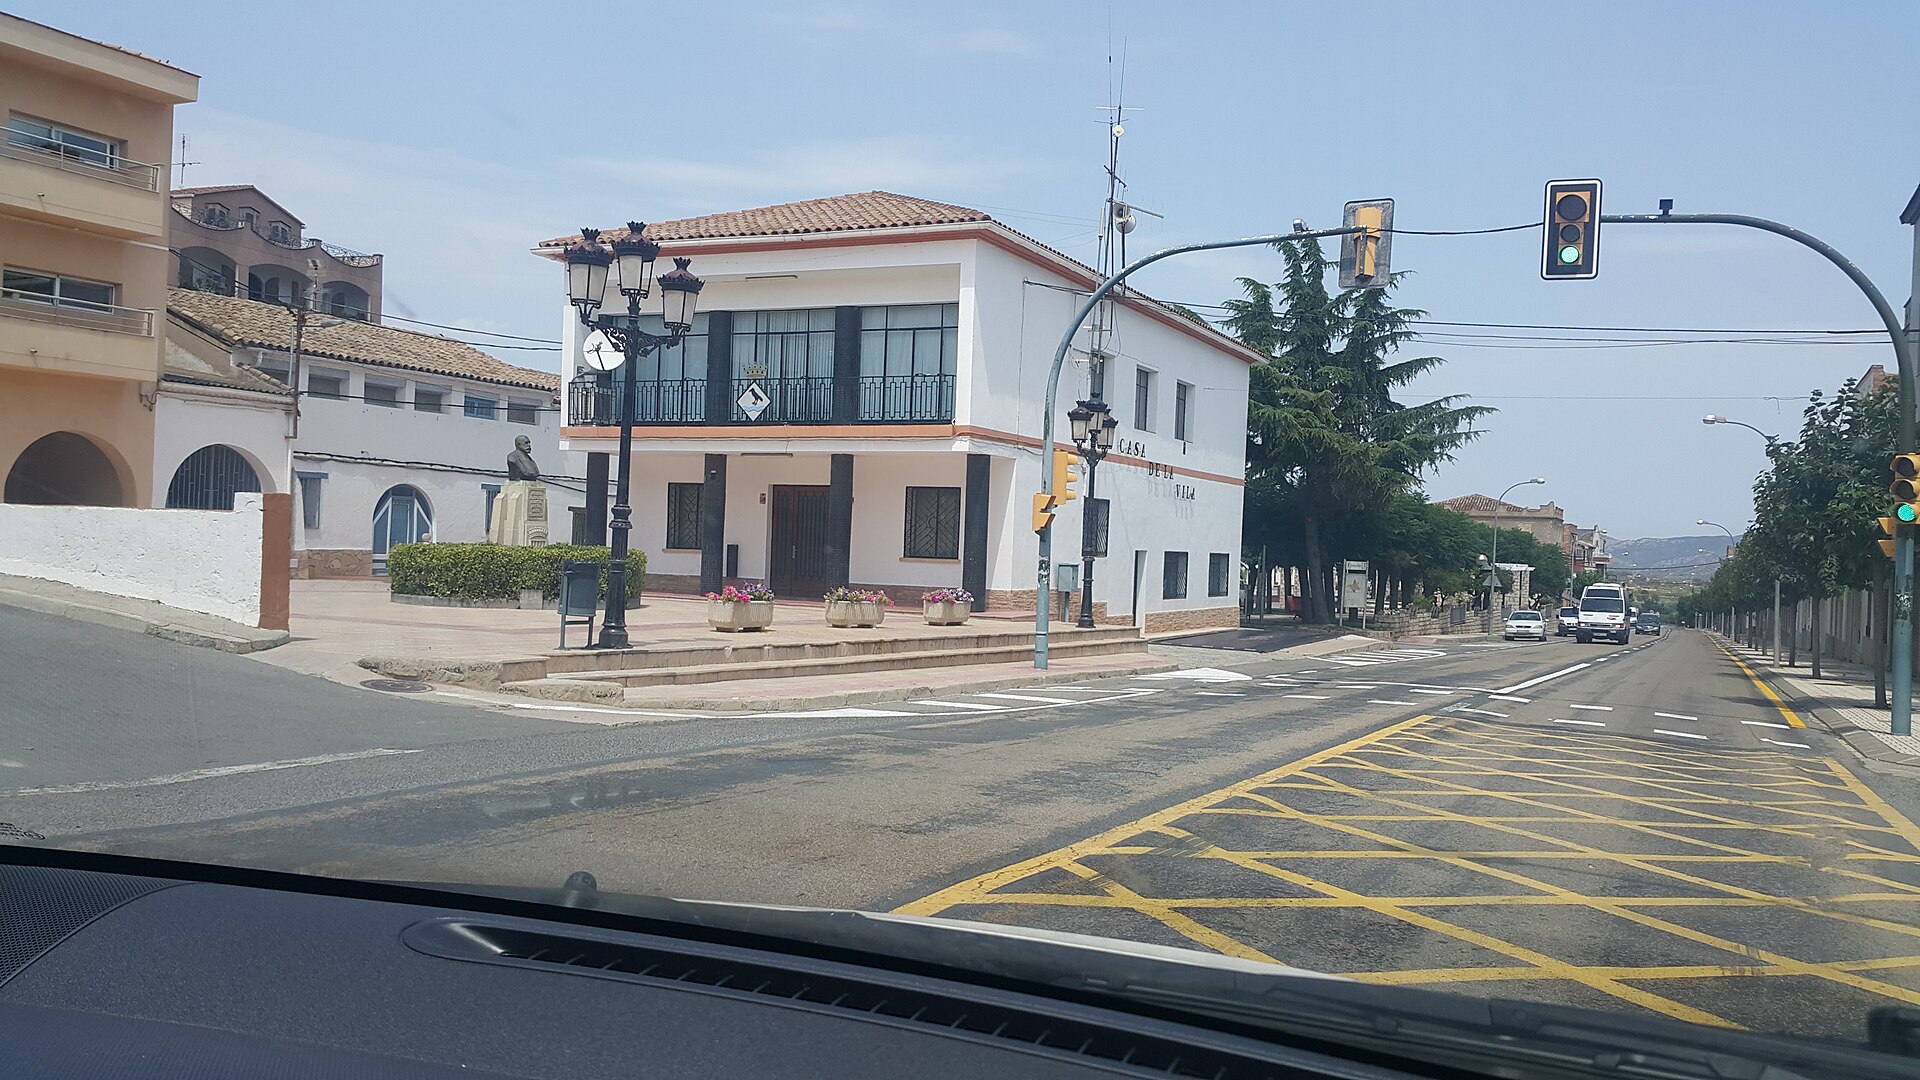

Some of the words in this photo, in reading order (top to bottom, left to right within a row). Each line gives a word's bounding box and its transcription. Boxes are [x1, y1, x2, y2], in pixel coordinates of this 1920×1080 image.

[1119, 438, 1146, 458] CASA
[1148, 461, 1161, 478] DE
[1163, 464, 1174, 480] LA
[1175, 484, 1196, 500] VILA
